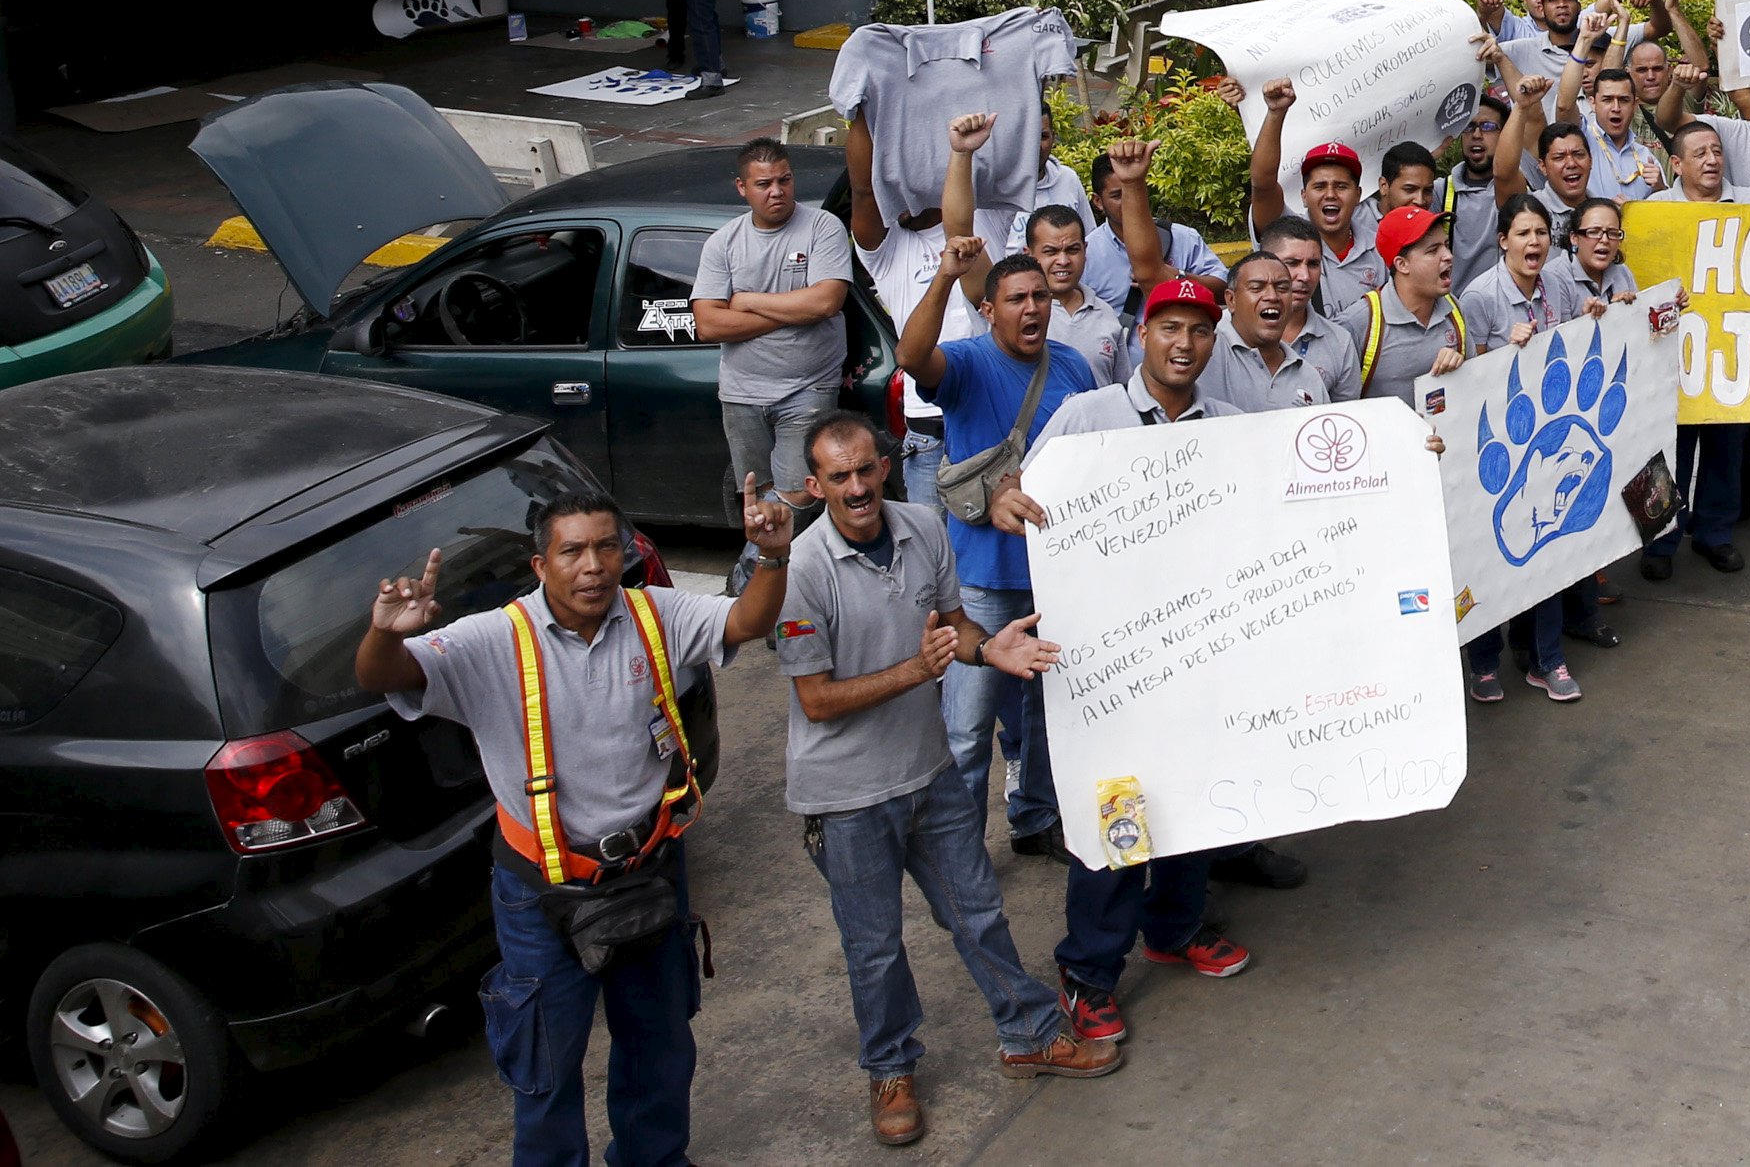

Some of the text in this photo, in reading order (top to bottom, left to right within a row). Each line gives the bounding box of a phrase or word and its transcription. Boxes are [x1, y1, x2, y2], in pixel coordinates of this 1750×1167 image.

[1300, 32, 1387, 88] QUEREMOS
[1309, 102, 1333, 123] NO
[1333, 92, 1343, 110] A
[1347, 80, 1363, 100] LA
[1393, 80, 1438, 110] SOMOS
[1178, 279, 1196, 299] A
[1129, 437, 1204, 482] POLAR
[1285, 476, 1351, 498] Alimentos
[1044, 477, 1196, 559] SOMOS TODOS LOS
[1053, 641, 1097, 676] NOS
[1100, 586, 1214, 649] ESFORZAMOS
[1225, 558, 1266, 590] CADA
[1317, 515, 1360, 547] PARA
[1066, 559, 1335, 703] LLEVARLES NUESTROS PRODUCTOS
[1081, 703, 1100, 728] A
[1101, 692, 1125, 720] LA
[1131, 664, 1175, 703] MESA
[1179, 645, 1209, 672] DE
[1209, 634, 1236, 661] LOS
[1304, 681, 1390, 718] ESFUERZO
